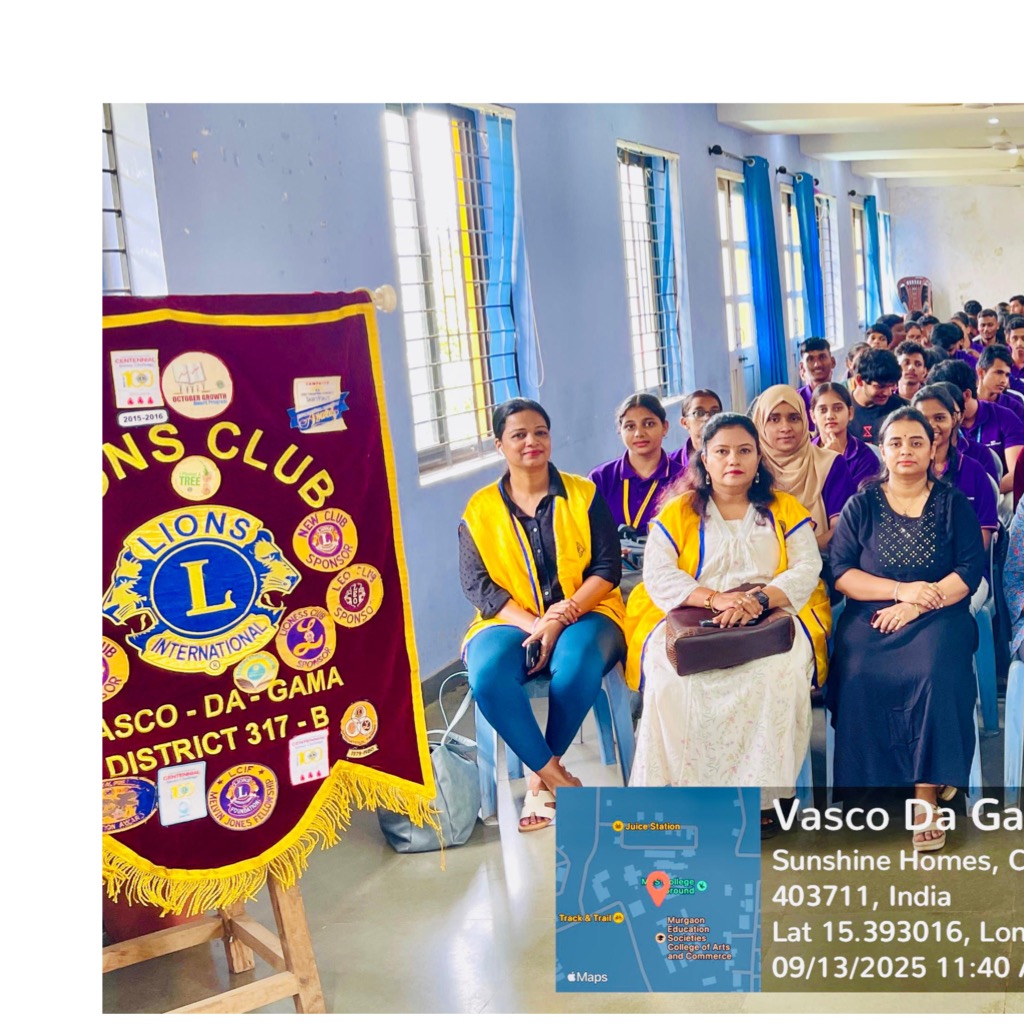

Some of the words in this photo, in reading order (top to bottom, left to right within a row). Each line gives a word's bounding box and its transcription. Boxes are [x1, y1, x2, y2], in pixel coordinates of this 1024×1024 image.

[172, 394, 201, 403] OCTOBER
[202, 392, 227, 401] GROWTH
[123, 412, 164, 423] 2015-2016
[207, 421, 335, 509] CLUB
[179, 476, 201, 486] TREE
[136, 511, 250, 555] LIONS
[298, 513, 319, 538] NEW
[324, 510, 348, 528] CLUB
[305, 543, 354, 570] SPONSOR
[180, 559, 237, 617] L
[332, 570, 351, 592] LEO
[279, 609, 308, 637] LIONESS
[151, 622, 268, 662] INTERNATIONAL
[296, 646, 333, 669] SPONSOR
[204, 688, 247, 718] DA
[267, 665, 344, 703] GAMA
[105, 726, 239, 778] DISTRICT
[244, 714, 289, 746] 317
[310, 705, 330, 729] B
[163, 770, 200, 781] CENTENNIAL
[227, 765, 254, 778] LCIF
[209, 791, 226, 821] MELVIN
[224, 818, 253, 828] JONES
[252, 778, 275, 823] FELLOWSHIP
